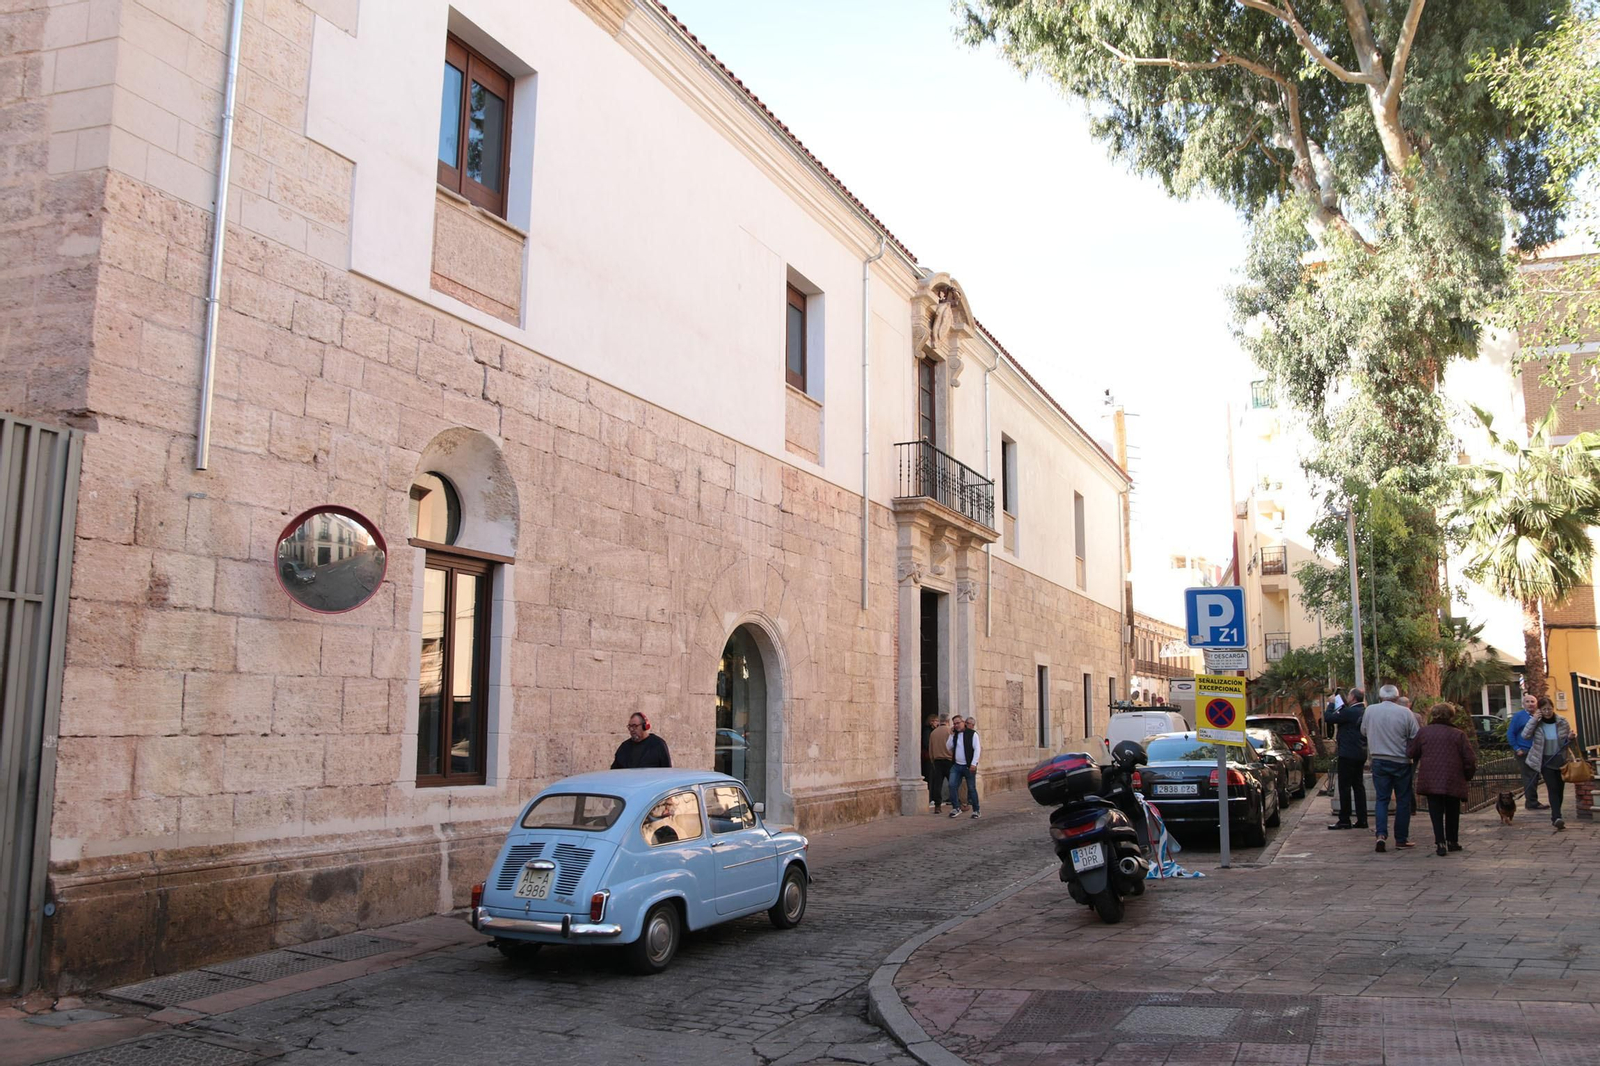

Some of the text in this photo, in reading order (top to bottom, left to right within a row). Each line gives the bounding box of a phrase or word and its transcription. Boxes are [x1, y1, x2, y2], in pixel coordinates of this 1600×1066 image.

[1196, 594, 1235, 643] P
[1218, 628, 1239, 642] Z1
[1198, 677, 1243, 686] SEÑALIZACIÓN
[1199, 685, 1242, 693] EXCEPCIONAL
[1159, 785, 1179, 793] 2838
[1078, 845, 1097, 858] 3147
[1082, 855, 1098, 867] DPR
[518, 884, 546, 898] 4986
